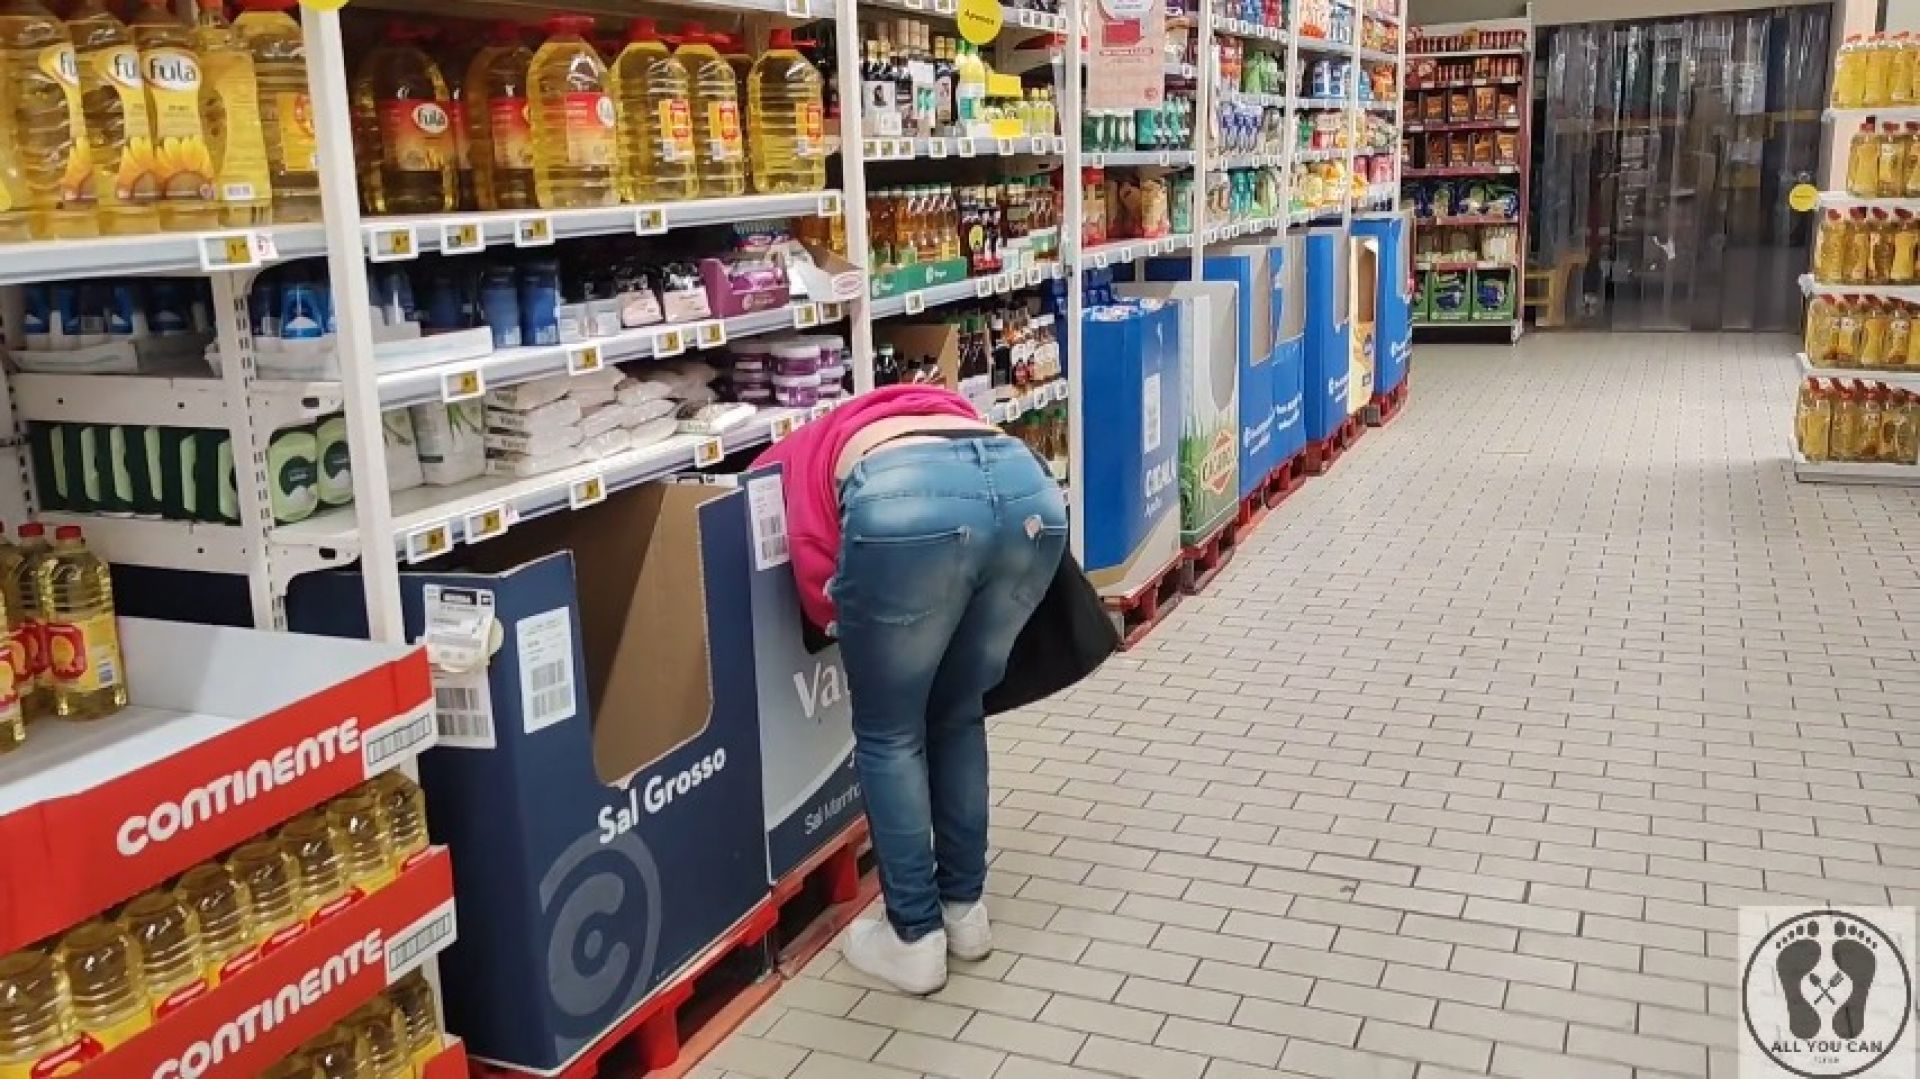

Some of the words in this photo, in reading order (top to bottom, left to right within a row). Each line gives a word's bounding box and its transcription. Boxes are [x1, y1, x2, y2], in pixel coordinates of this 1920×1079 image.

[116, 716, 361, 857] CONTINENTE
[597, 788, 639, 844] Sal
[643, 747, 727, 814] Grosso
